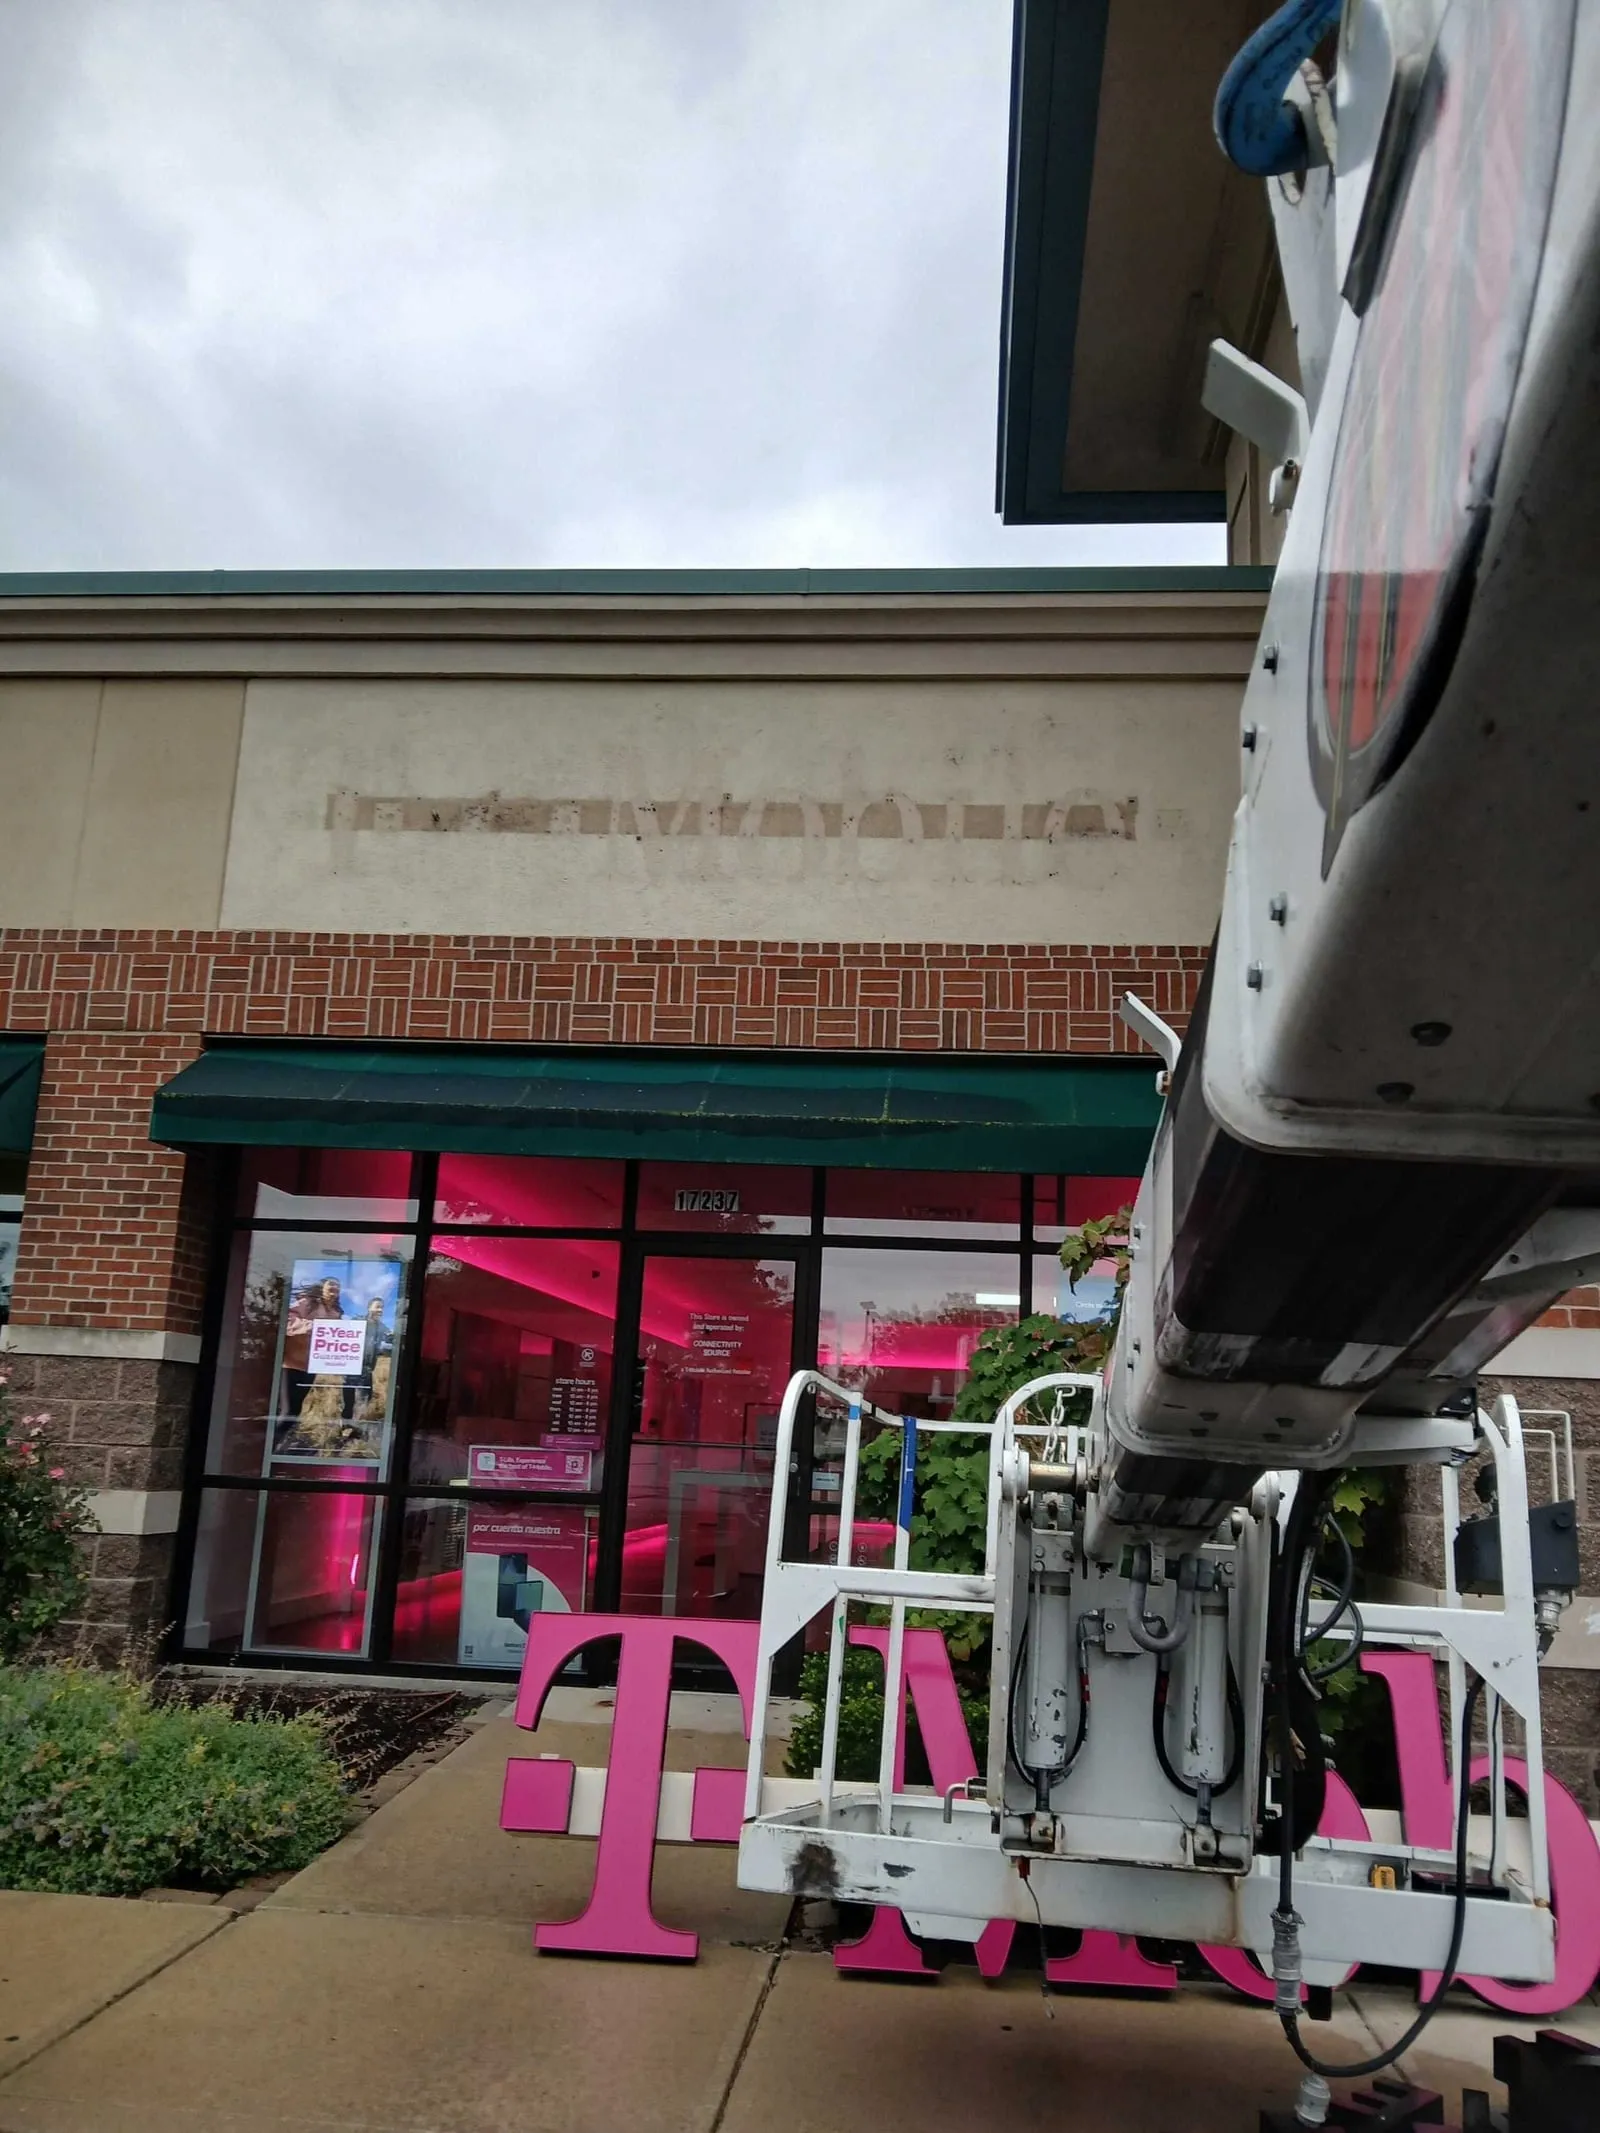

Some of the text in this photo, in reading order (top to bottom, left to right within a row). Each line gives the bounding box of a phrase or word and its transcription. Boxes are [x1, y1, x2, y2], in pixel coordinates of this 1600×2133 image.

[677, 1190, 738, 1210] 17237
[689, 1312, 703, 1320] This
[704, 1313, 720, 1321] Store
[316, 1326, 362, 1338] 5-Year
[314, 1339, 360, 1353] Price
[693, 1340, 742, 1348] CONNECTIVITY
[703, 1349, 730, 1357] SOURCE
[575, 1377, 596, 1386] hours
[472, 1523, 560, 1535] por cuenta nuestra
